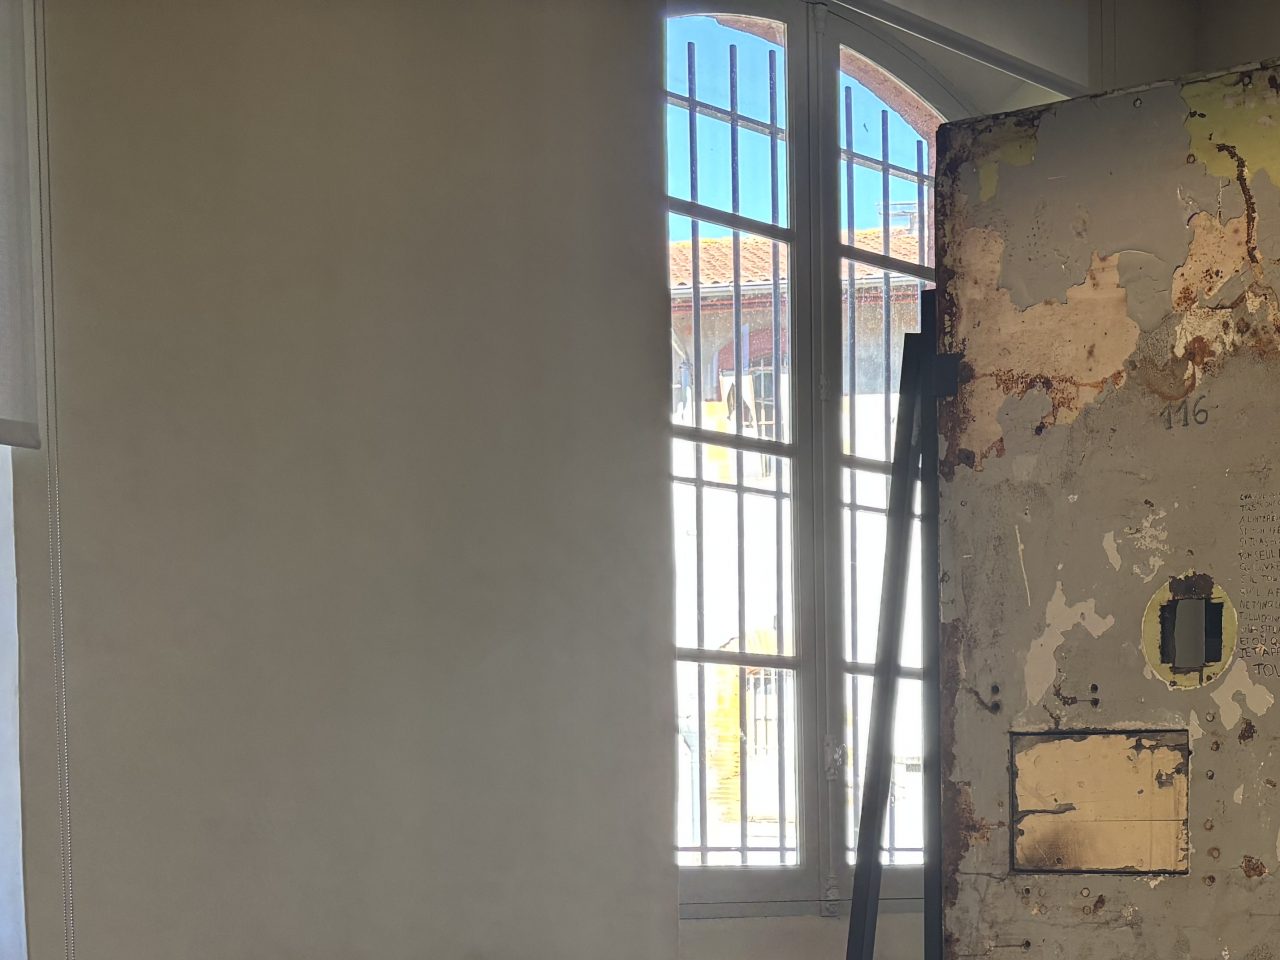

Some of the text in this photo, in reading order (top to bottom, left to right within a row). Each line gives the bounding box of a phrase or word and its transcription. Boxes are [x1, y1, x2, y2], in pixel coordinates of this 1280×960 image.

[1159, 394, 1209, 430] 116
[1254, 548, 1276, 562] SEUL
[1239, 599, 1251, 611] NE
